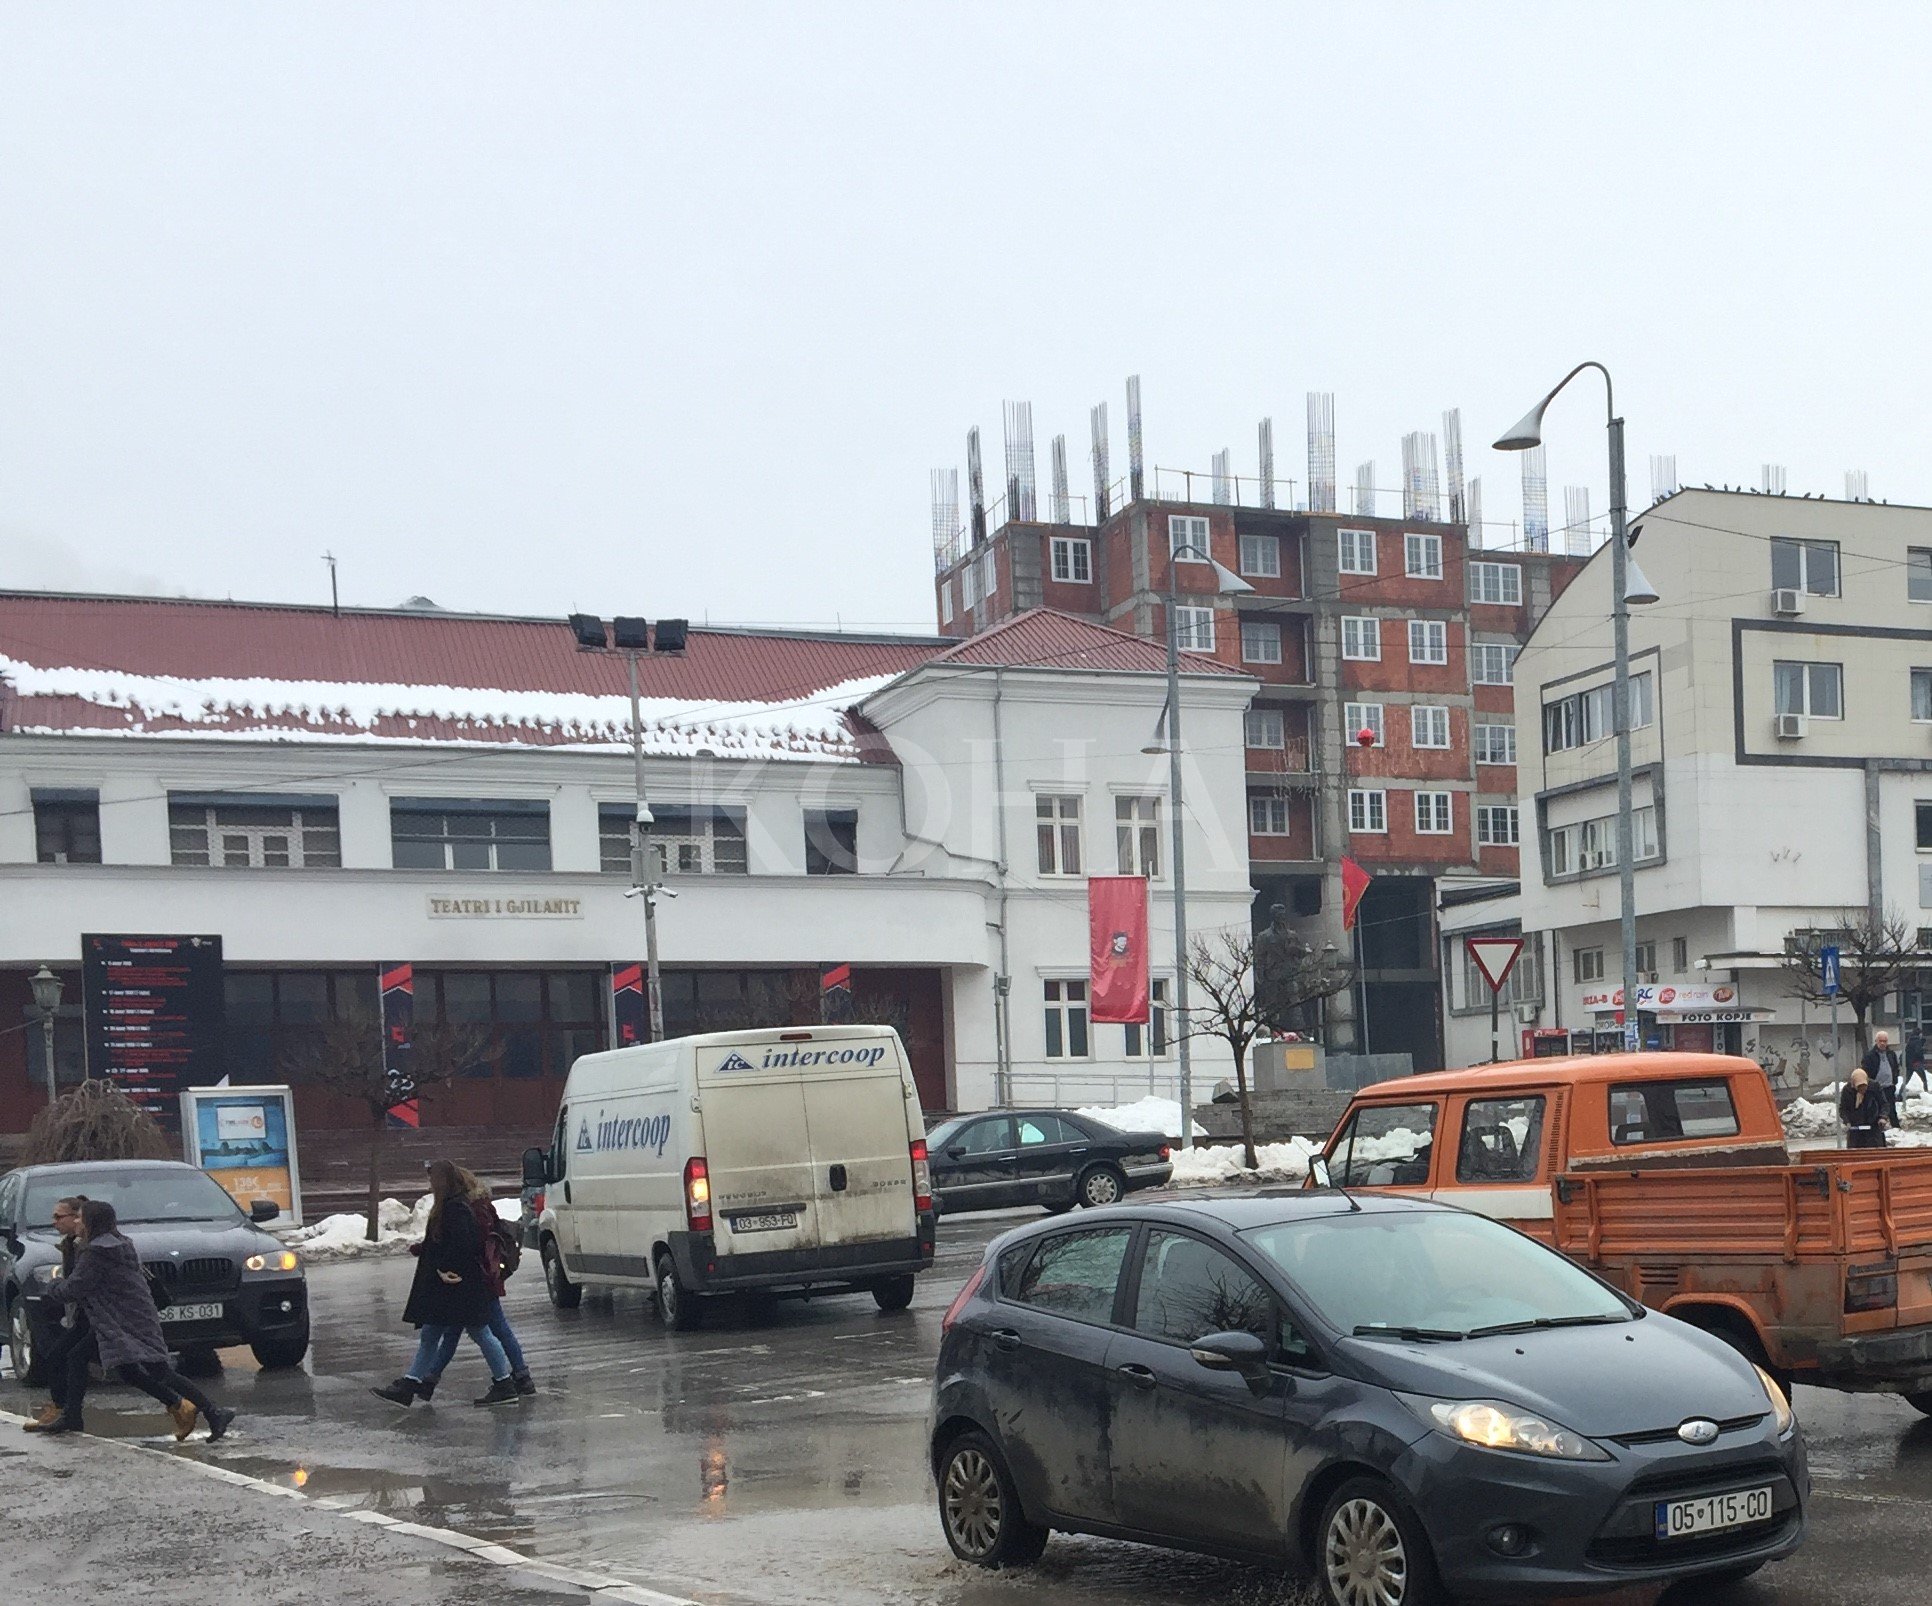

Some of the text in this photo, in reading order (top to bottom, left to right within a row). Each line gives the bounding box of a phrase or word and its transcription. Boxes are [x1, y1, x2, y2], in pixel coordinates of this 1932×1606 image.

[431, 899, 581, 914] TEATRI I GJILANIT
[1681, 1013, 1712, 1022] FOTO
[1716, 1012, 1752, 1021] KOPJE
[761, 1046, 886, 1069] intercoop
[597, 1109, 671, 1158] intercoop
